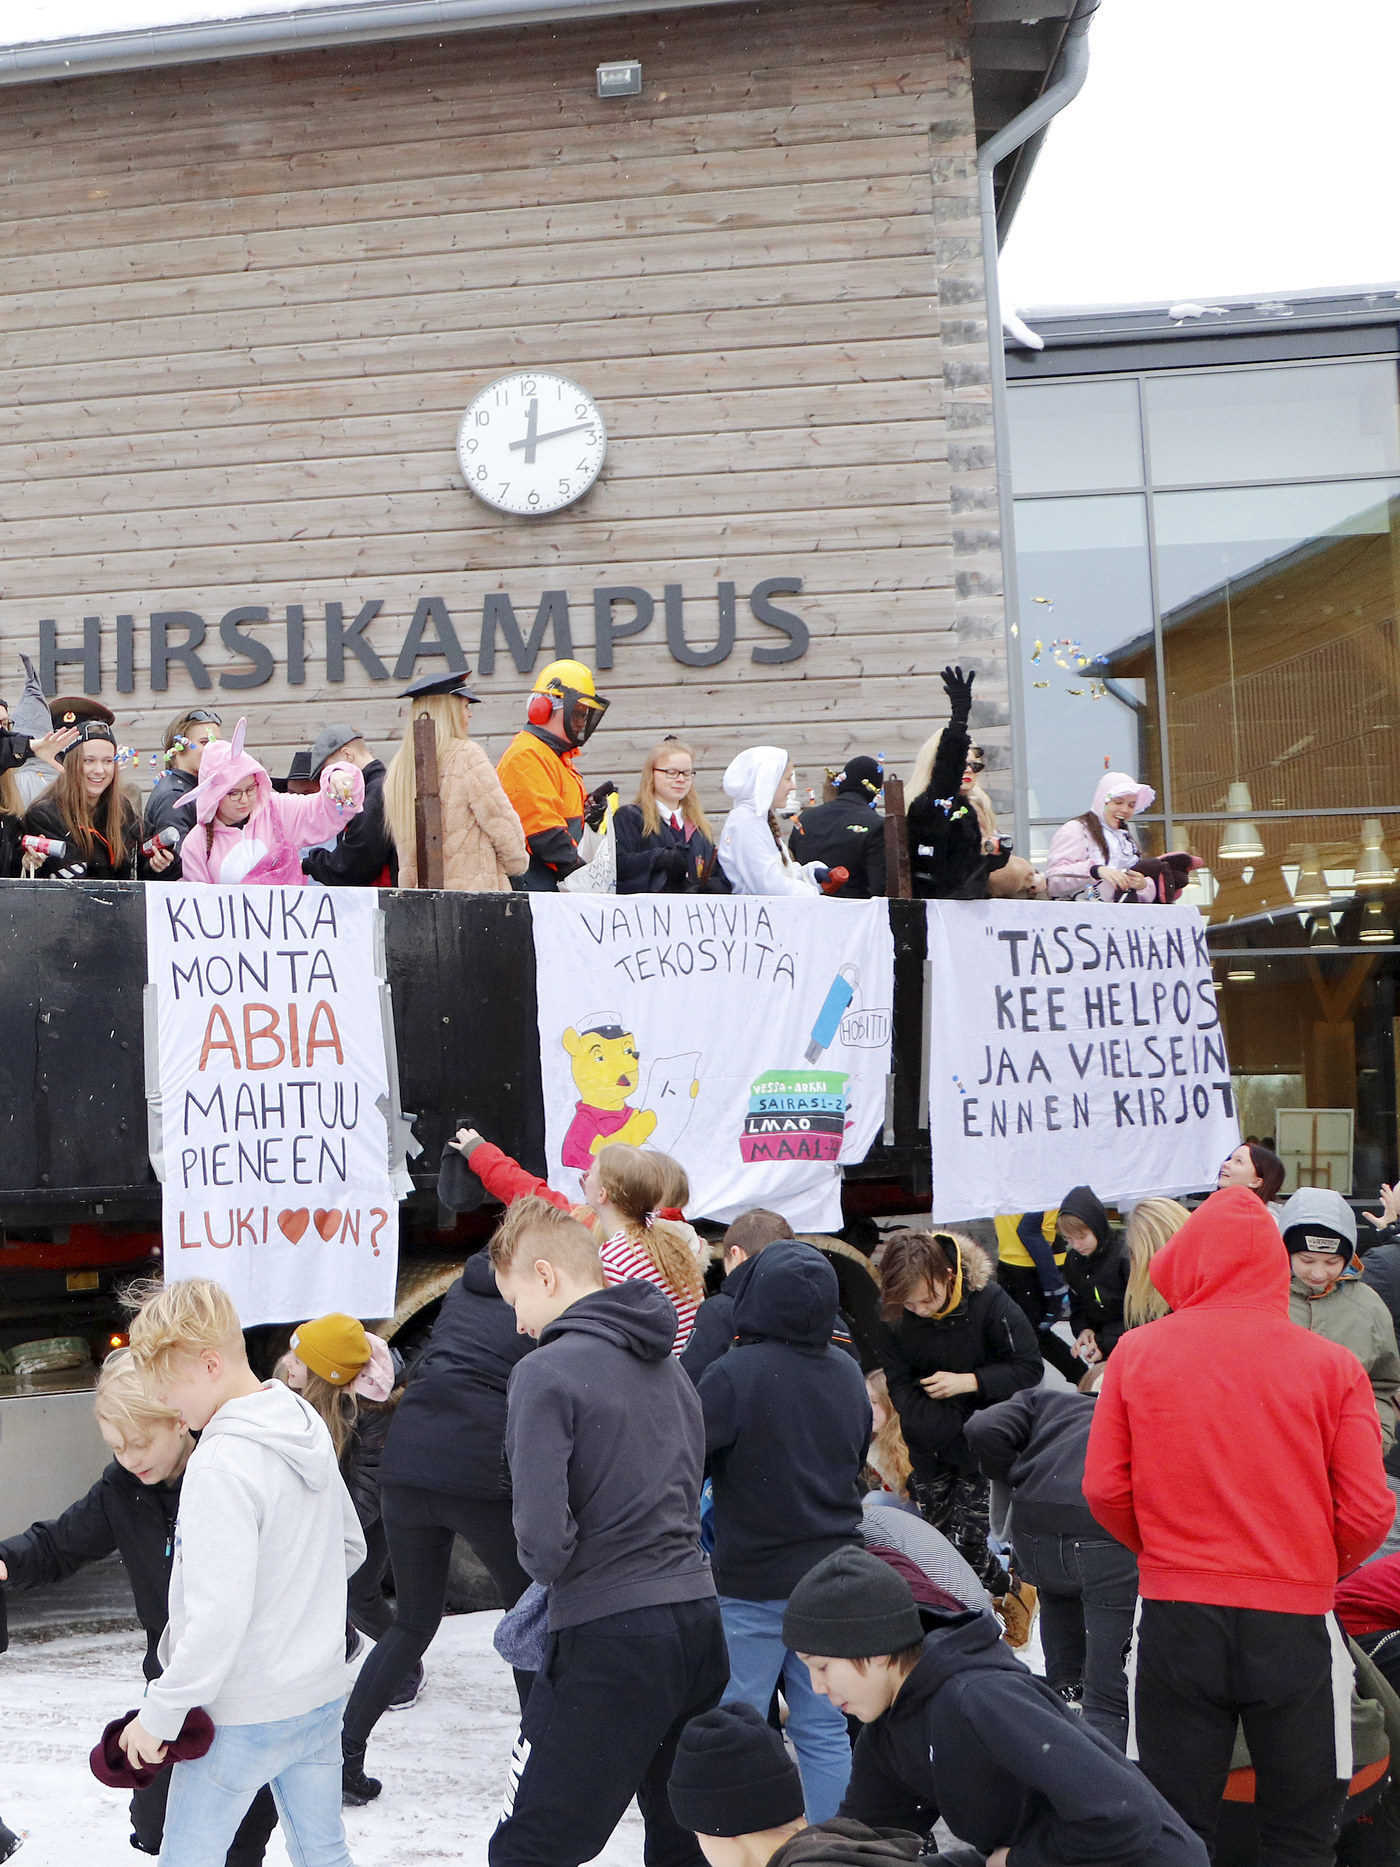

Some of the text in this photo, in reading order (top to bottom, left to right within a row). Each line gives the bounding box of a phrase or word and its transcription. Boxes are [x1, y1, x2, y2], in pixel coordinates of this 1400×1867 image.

[521, 380, 537, 396] 12
[496, 390, 508, 406] 11
[475, 410, 489, 426] 10
[575, 404, 588, 420] 2
[466, 438, 478, 454] 9
[585, 430, 597, 446] 3
[476, 464, 488, 481] 8
[576, 457, 590, 473] 4
[499, 482, 510, 499] 7
[558, 478, 570, 495] 5
[528, 489, 540, 505] 6
[38, 576, 809, 696] HIRSIKAMPUS
[165, 890, 338, 942] KUINKA
[580, 899, 774, 944] VAIN HYVIÄ
[613, 939, 798, 989] TEKOSYITÄ
[171, 948, 338, 999] MONTA
[994, 979, 1220, 1032] KEE HELPOS
[198, 1000, 344, 1071] ABIA
[978, 1044, 1052, 1086] JAA
[183, 1081, 359, 1135] MAHTUU
[963, 1081, 1234, 1138] ENNEN KIRJOT
[748, 1118, 811, 1133] LMAO
[181, 1135, 347, 1188] PIENEEN
